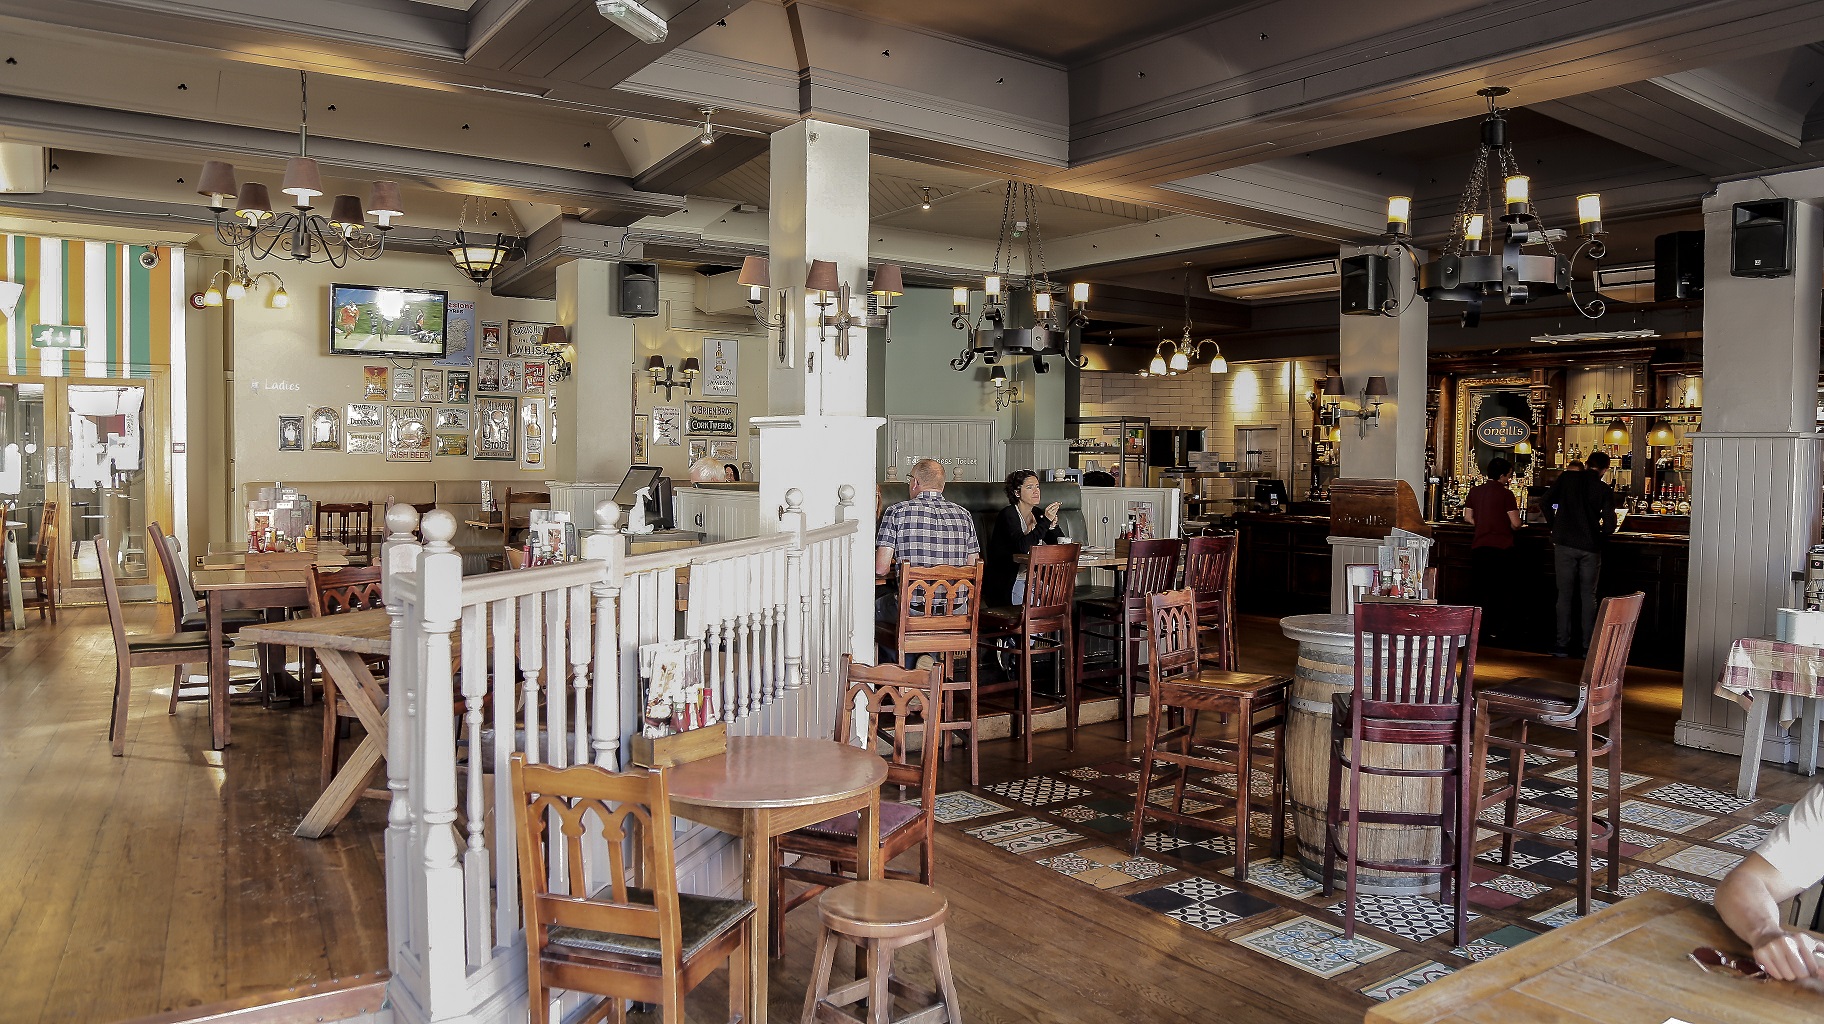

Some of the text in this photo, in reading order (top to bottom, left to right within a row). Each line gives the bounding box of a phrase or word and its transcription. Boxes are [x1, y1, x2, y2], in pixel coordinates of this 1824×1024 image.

[514, 345, 550, 356] WHISK
[264, 378, 300, 391] Ladies
[390, 408, 430, 420] KILKENNY
[691, 420, 709, 430] CORK
[1483, 425, 1523, 436] o'neill's
[389, 451, 429, 459] IRISH BEER
[956, 457, 977, 466] Toilet
